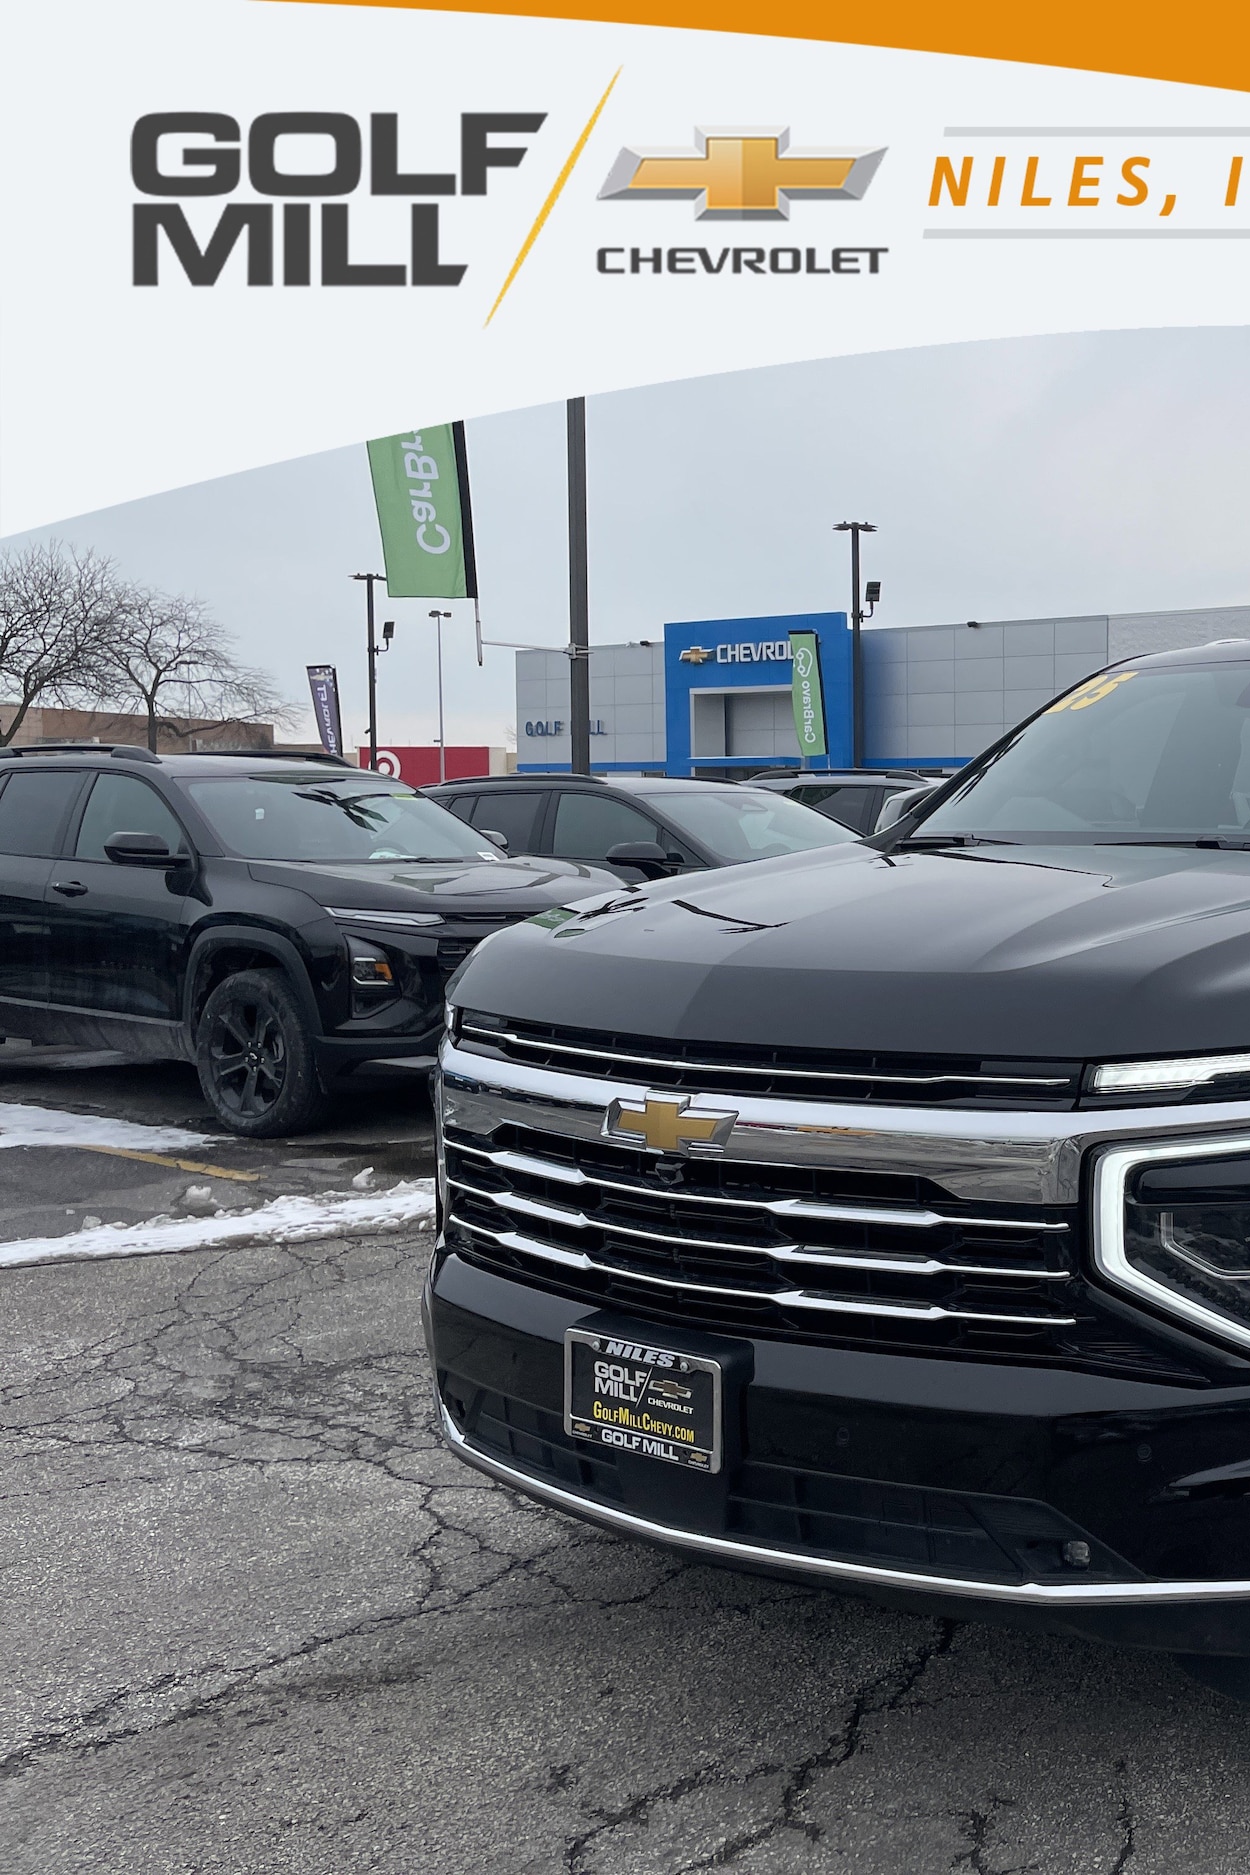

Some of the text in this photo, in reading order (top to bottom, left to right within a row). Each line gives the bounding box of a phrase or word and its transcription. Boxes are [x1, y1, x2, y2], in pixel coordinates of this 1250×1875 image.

[717, 640, 795, 664] CHEVROL
[525, 720, 564, 737] GOLF
[606, 1341, 676, 1368] NILES
[594, 1361, 648, 1387] GOLF
[594, 1377, 638, 1403] MILL
[648, 1397, 694, 1415] CHEVROLET
[601, 1429, 679, 1461] GOLF MILL
